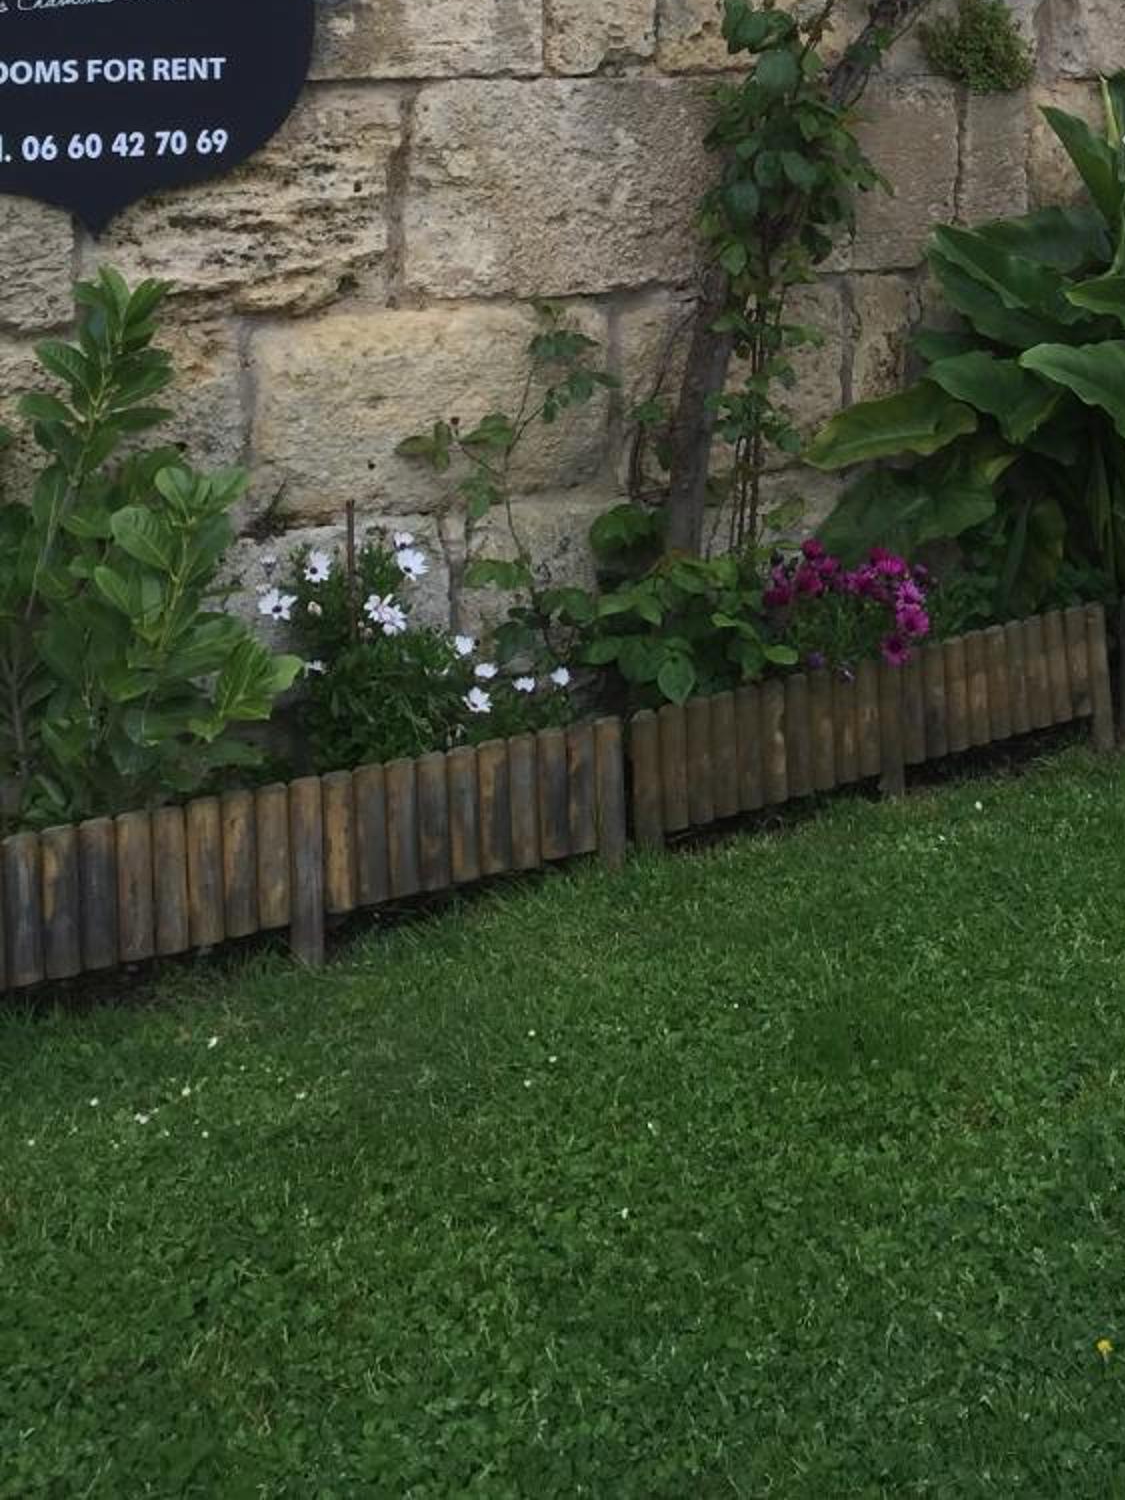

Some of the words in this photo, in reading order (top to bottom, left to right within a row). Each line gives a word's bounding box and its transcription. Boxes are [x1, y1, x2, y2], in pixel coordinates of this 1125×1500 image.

[86, 58, 145, 83] FOR
[152, 57, 226, 81] RENT
[21, 135, 58, 161] 06
[67, 133, 103, 159] 60
[111, 131, 145, 157] 42
[154, 130, 187, 155] 70
[196, 129, 228, 154] 69
